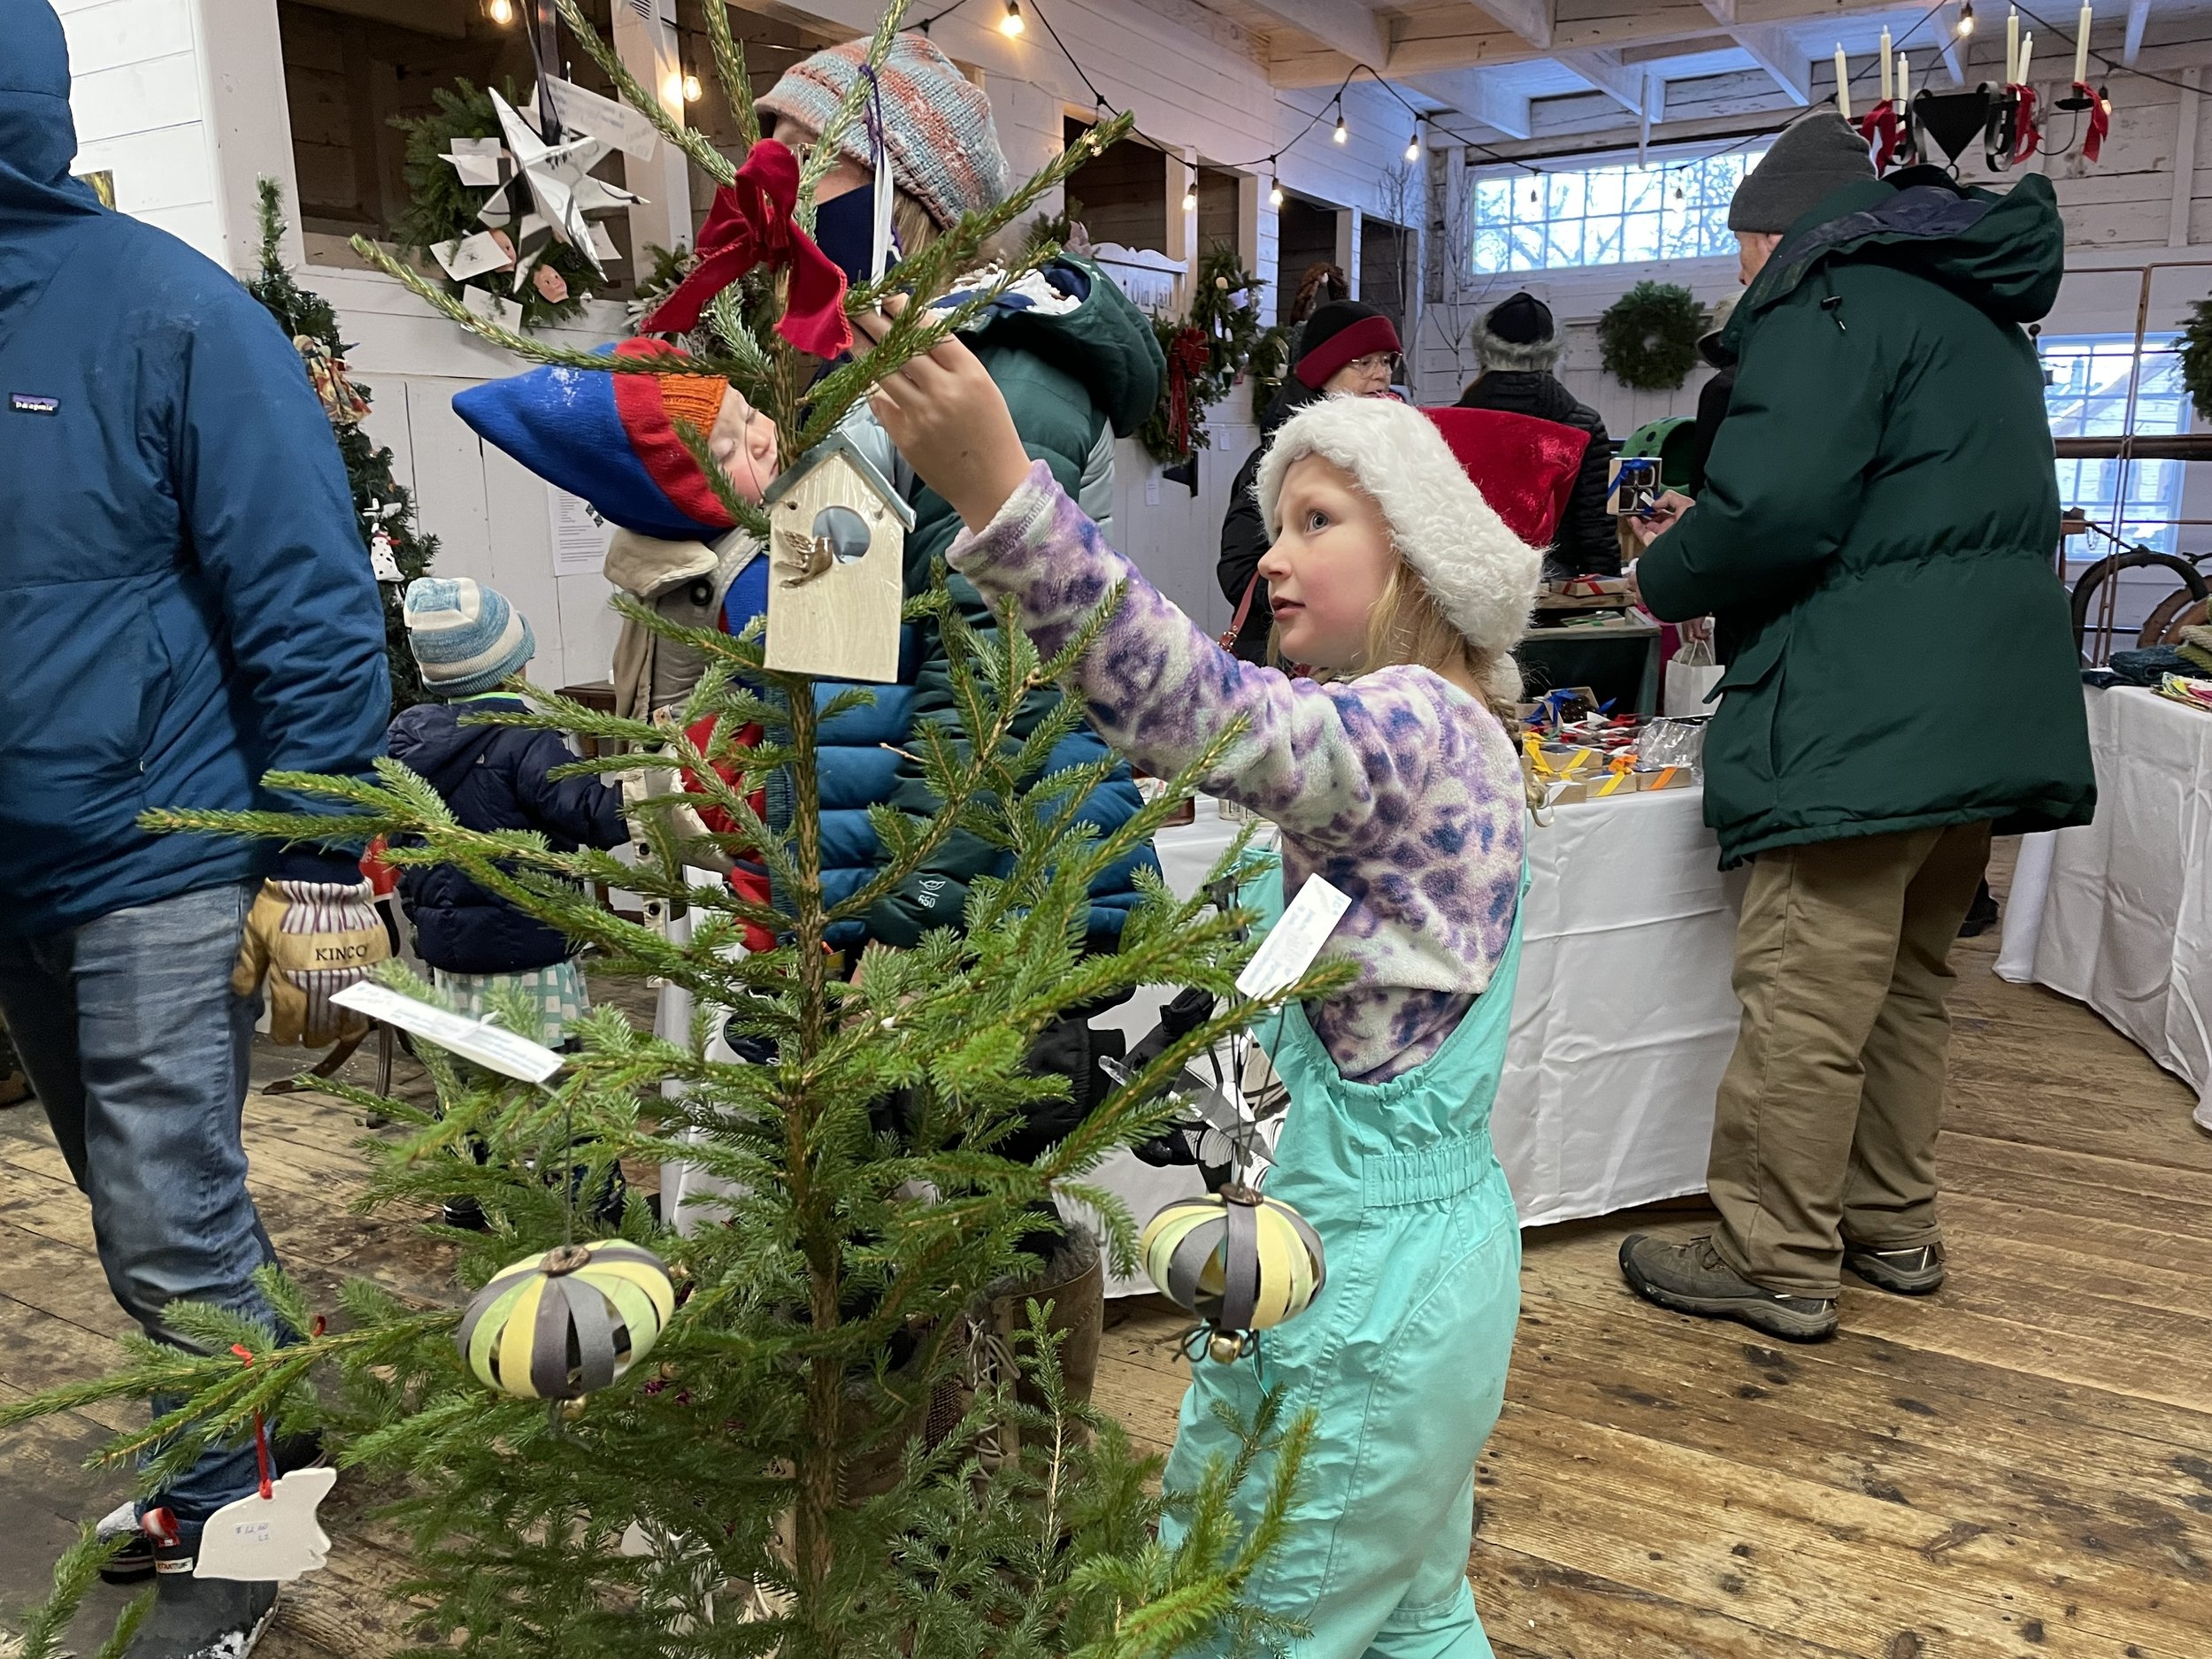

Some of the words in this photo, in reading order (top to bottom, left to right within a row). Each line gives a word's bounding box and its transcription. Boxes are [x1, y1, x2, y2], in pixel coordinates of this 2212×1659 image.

[16, 401, 53, 411] paagonia
[918, 895, 935, 909] 650
[315, 944, 368, 962] KINCO
